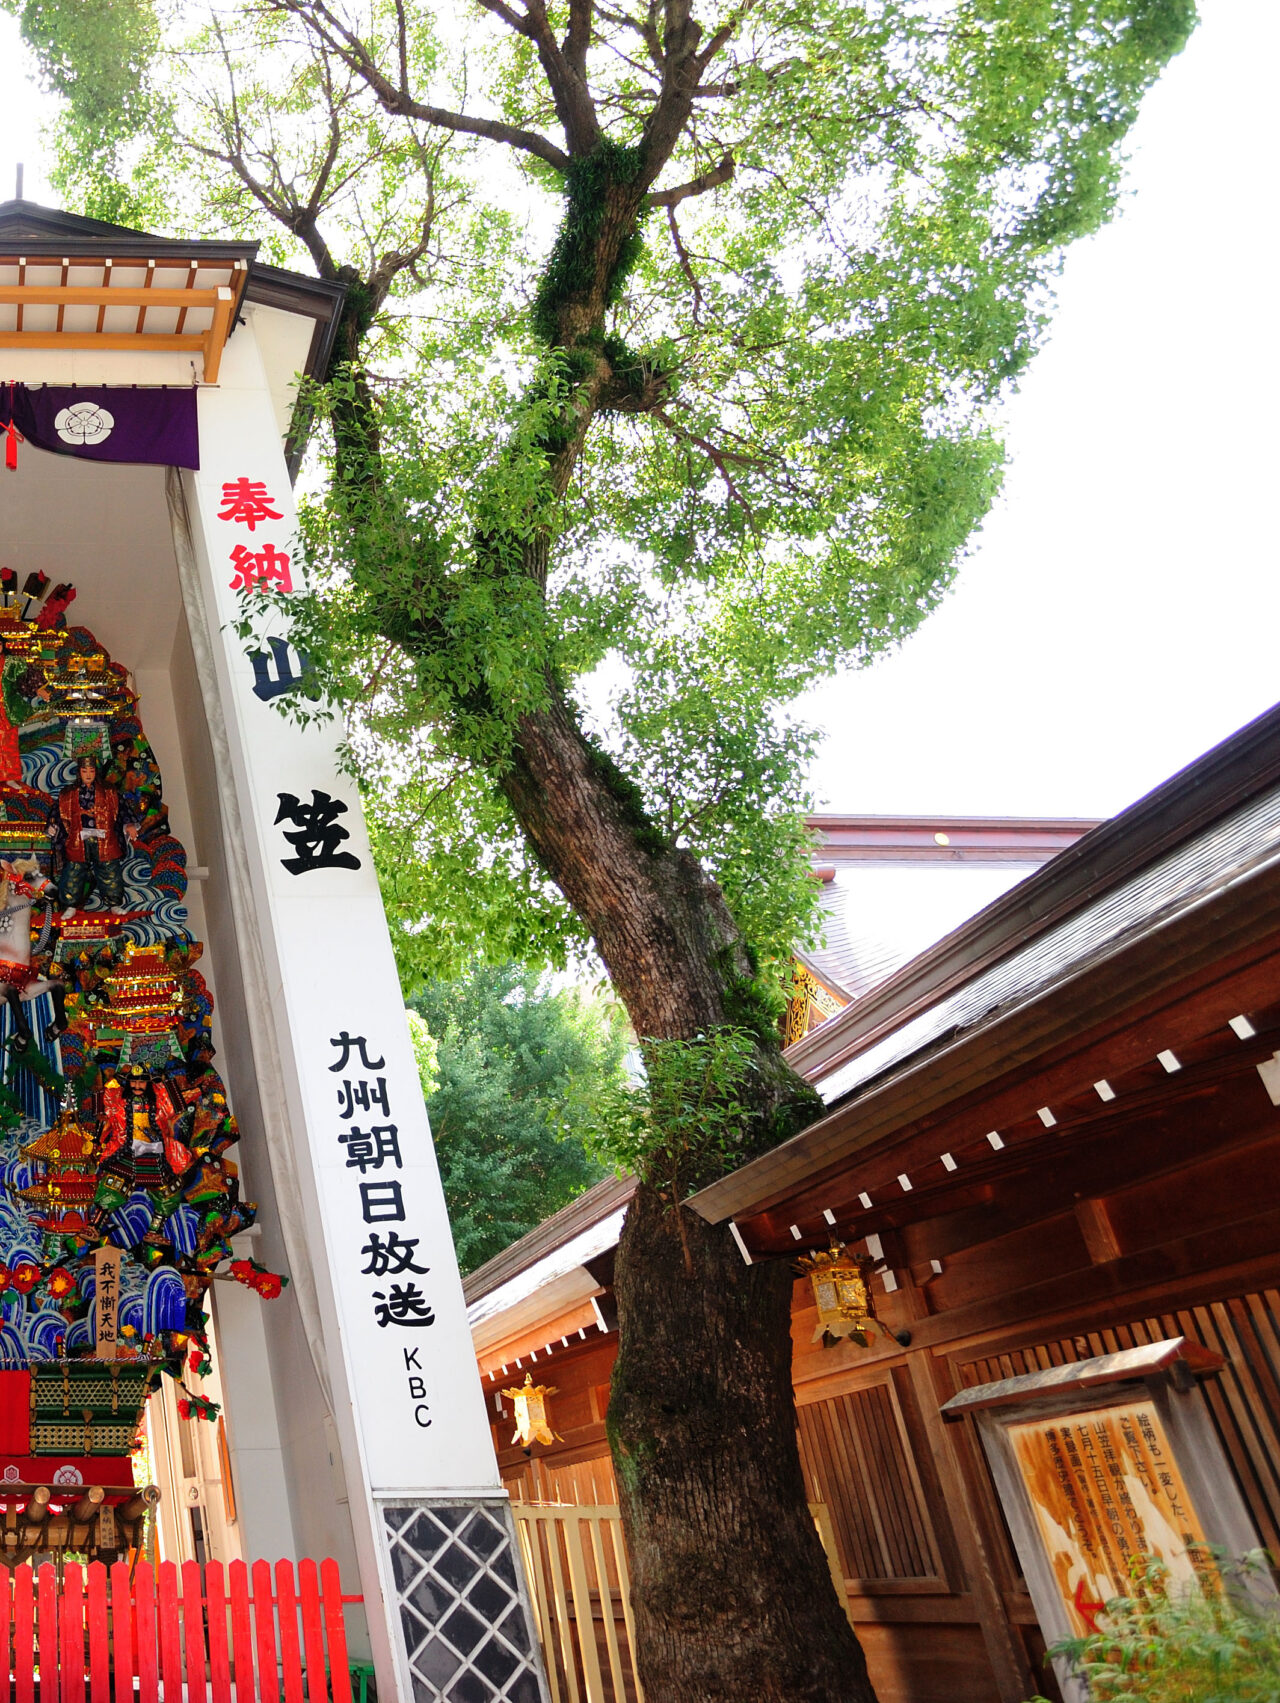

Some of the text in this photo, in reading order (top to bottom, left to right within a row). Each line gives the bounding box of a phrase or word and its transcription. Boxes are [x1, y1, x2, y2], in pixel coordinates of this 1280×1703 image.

[217, 477, 293, 593] 奉納
[327, 1031, 435, 1328] 九州朝日放送
[403, 1347, 432, 1428] KBC
